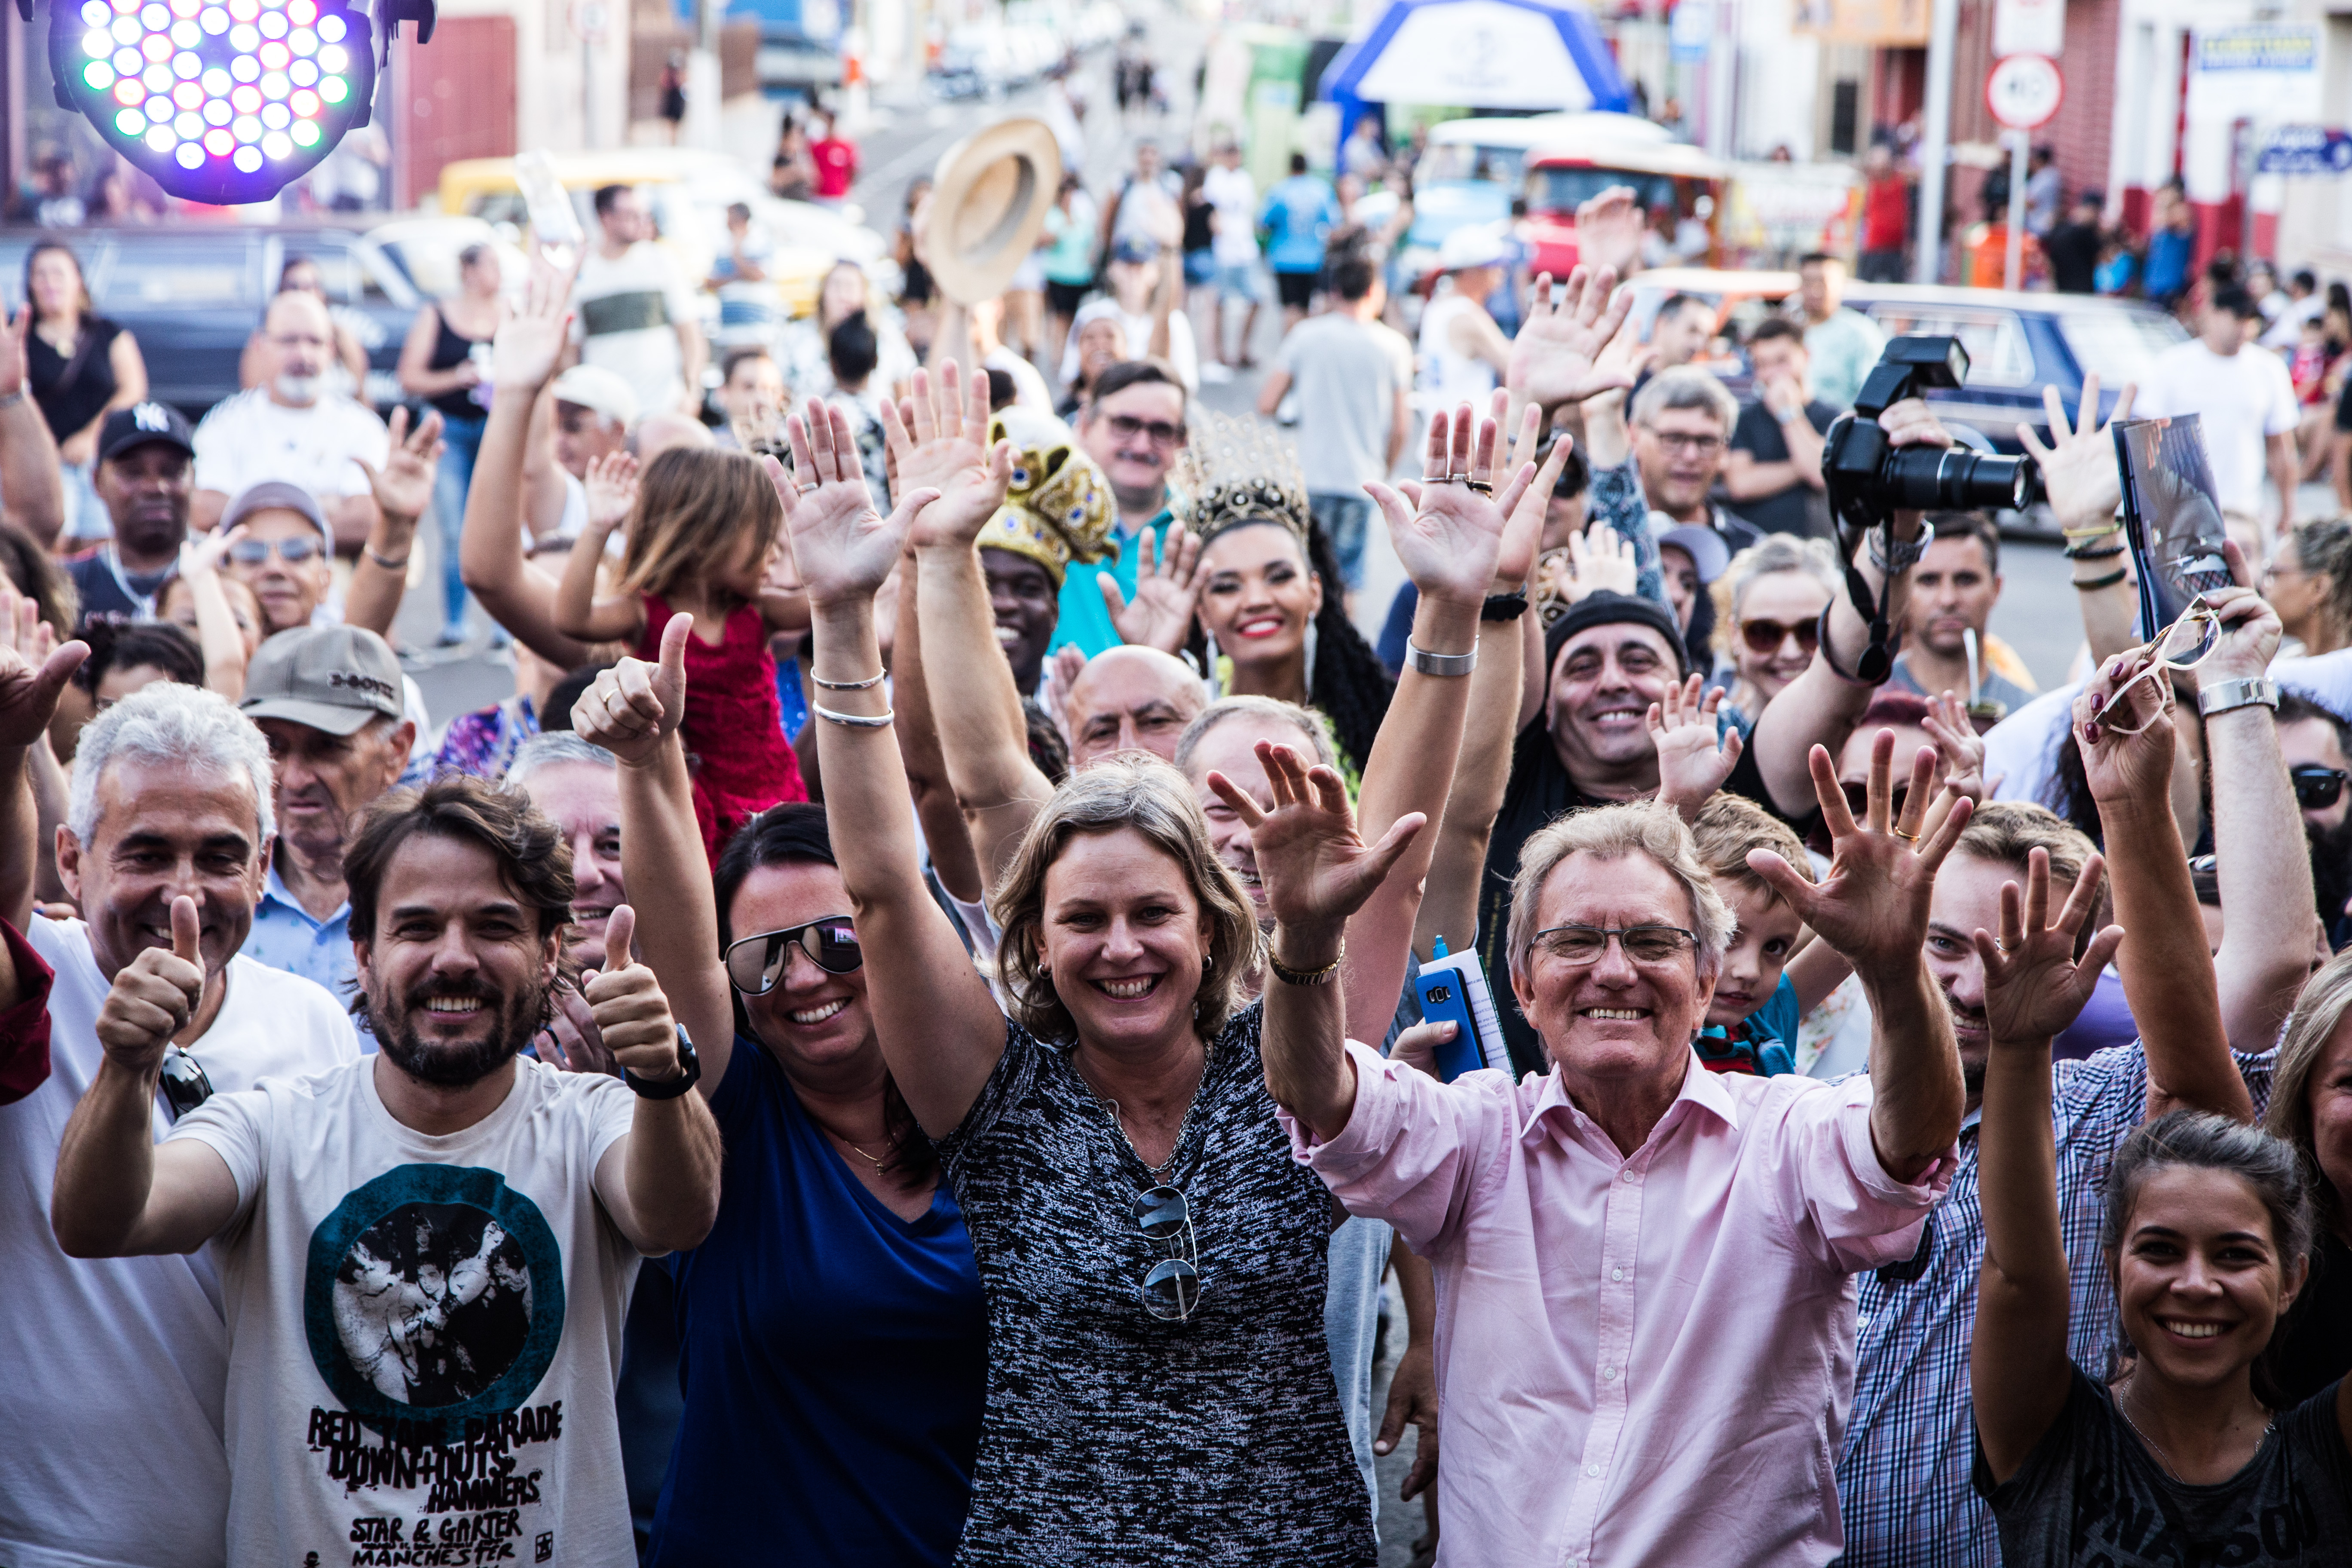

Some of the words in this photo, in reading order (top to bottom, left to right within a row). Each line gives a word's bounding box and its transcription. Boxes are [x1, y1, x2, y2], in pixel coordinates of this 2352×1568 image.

[306, 1407, 362, 1448] RED
[375, 1416, 448, 1452] TAPE
[465, 1400, 563, 1454] PARADE
[426, 1470, 541, 1514] HAMMERS
[349, 1517, 404, 1543] STAR
[413, 1518, 430, 1543] &
[438, 1509, 523, 1542] GARTER
[352, 1543, 516, 1567] MANCHESTER
